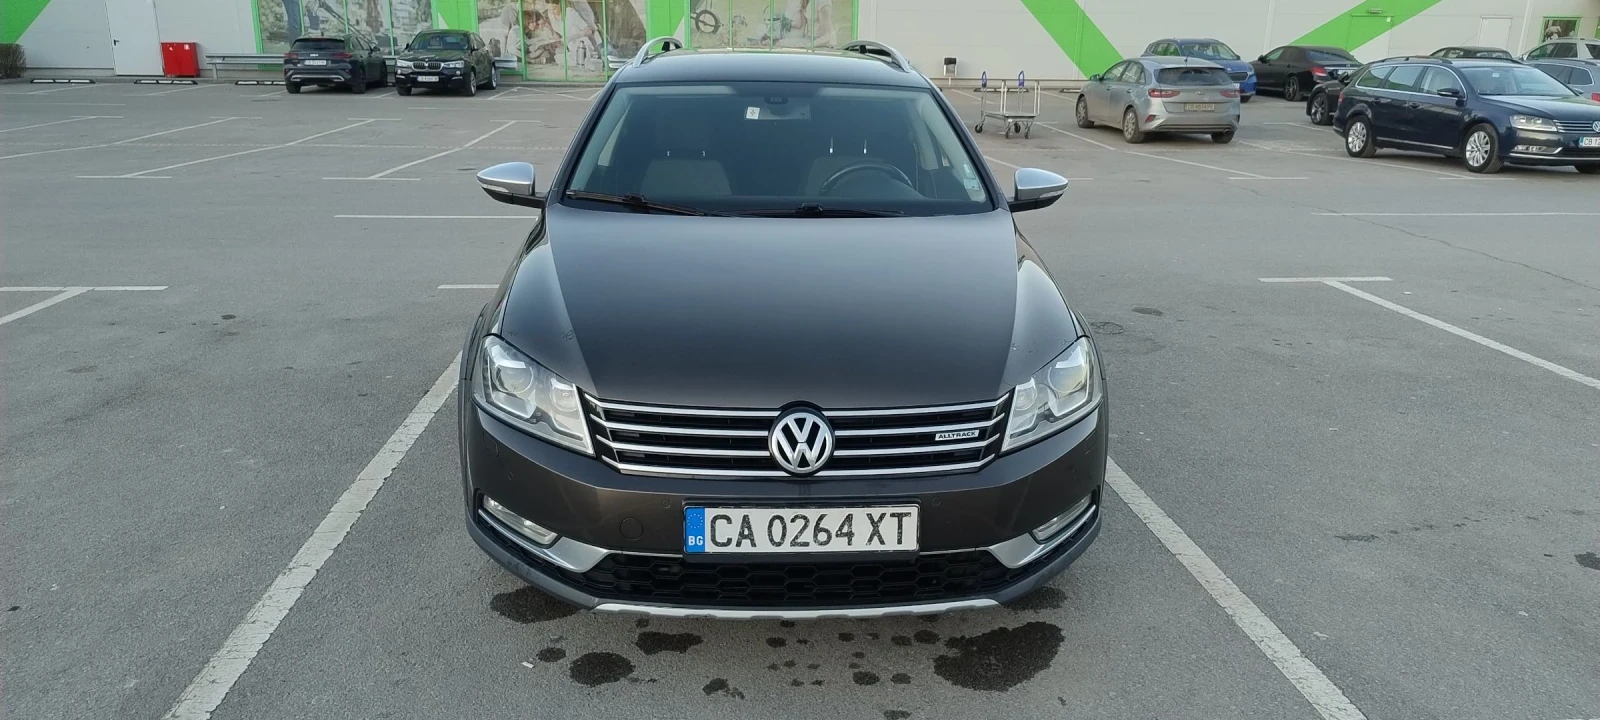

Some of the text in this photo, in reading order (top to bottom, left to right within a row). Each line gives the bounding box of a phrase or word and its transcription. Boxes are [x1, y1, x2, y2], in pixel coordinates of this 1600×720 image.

[938, 431, 976, 439] ALLTRACK
[710, 511, 912, 548] CA 0264 XT
[688, 536, 704, 546] BG
